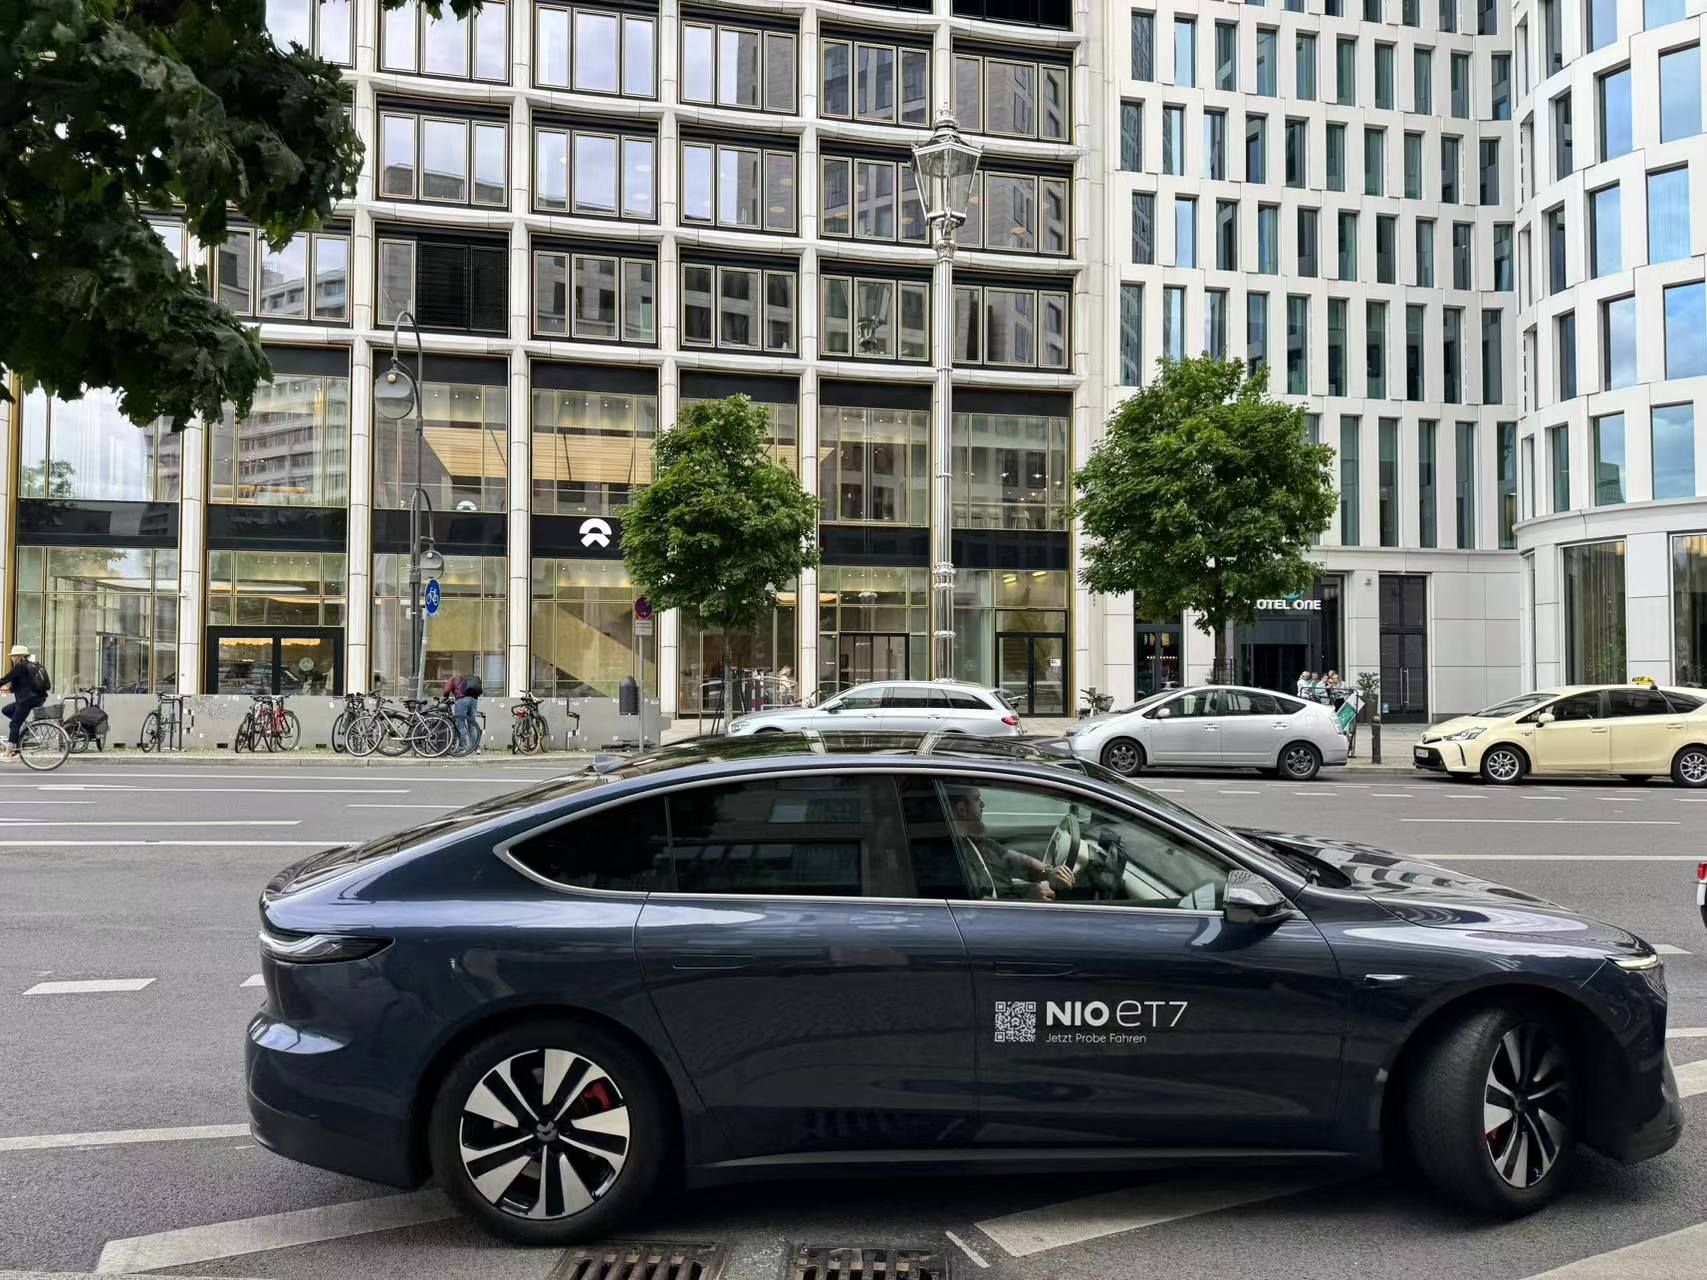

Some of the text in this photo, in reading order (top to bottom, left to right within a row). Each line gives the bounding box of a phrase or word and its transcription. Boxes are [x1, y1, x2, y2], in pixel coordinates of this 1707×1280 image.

[1254, 599, 1290, 610] OTEL
[1046, 1001, 1110, 1027] NIO
[1046, 1033, 1147, 1044] Jetzt Probe Fahren
